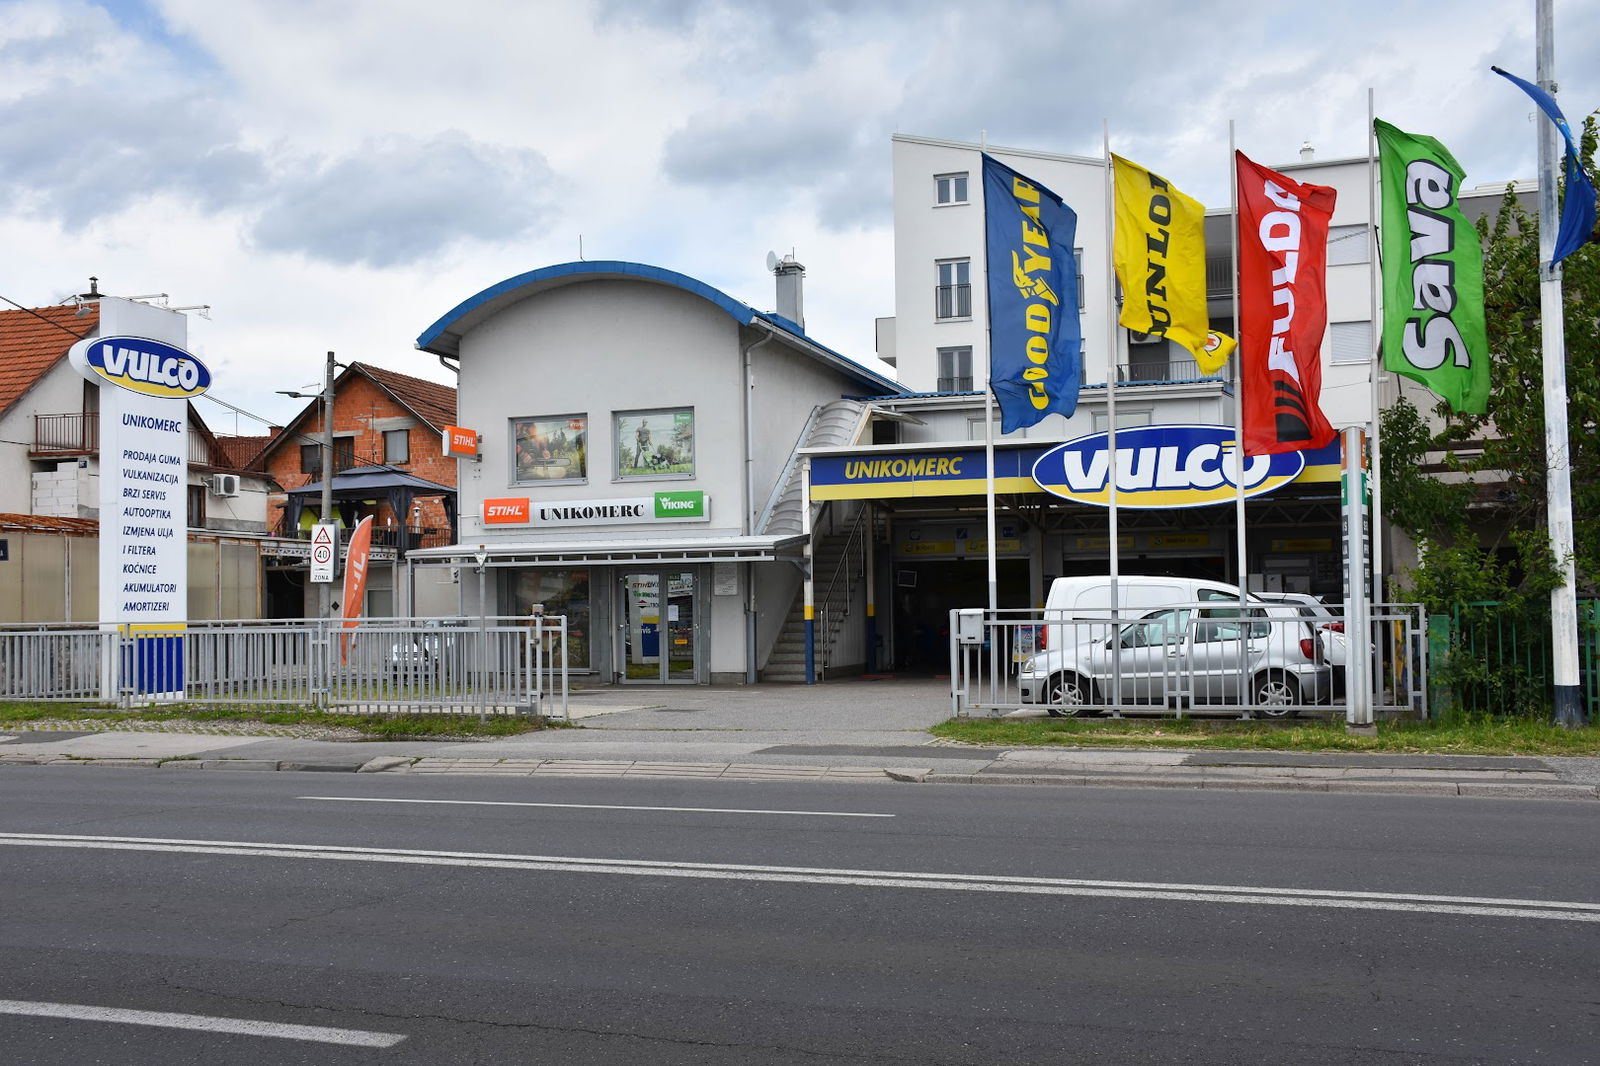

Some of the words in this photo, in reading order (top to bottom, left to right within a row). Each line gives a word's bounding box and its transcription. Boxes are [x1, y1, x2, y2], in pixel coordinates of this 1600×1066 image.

[1402, 159, 1471, 370] Sava
[103, 344, 199, 391] VULCO
[122, 413, 182, 433] UNIKOMERC
[453, 434, 476, 447] STIHL
[122, 449, 157, 464] PRODAJA
[158, 454, 181, 465] GUMA
[845, 457, 964, 479] UNIKOMERC
[1064, 443, 1271, 491] VULCO
[122, 468, 179, 485] VULKANIZACIJA
[122, 488, 140, 498] BRZI
[142, 489, 166, 501] SERVIS
[660, 498, 694, 510] VIKING
[122, 507, 171, 519] AUTOOPTIKA
[488, 506, 523, 516] STIHL
[540, 503, 645, 520] UNIKOMERC
[122, 525, 155, 538] IZMJENA
[157, 528, 174, 539] ULJA
[122, 545, 126, 555] I
[127, 545, 156, 555] FILTERA
[317, 550, 328, 558] 40
[122, 583, 177, 593] AKUMULATORI
[122, 602, 170, 611] AMORTIZERI
